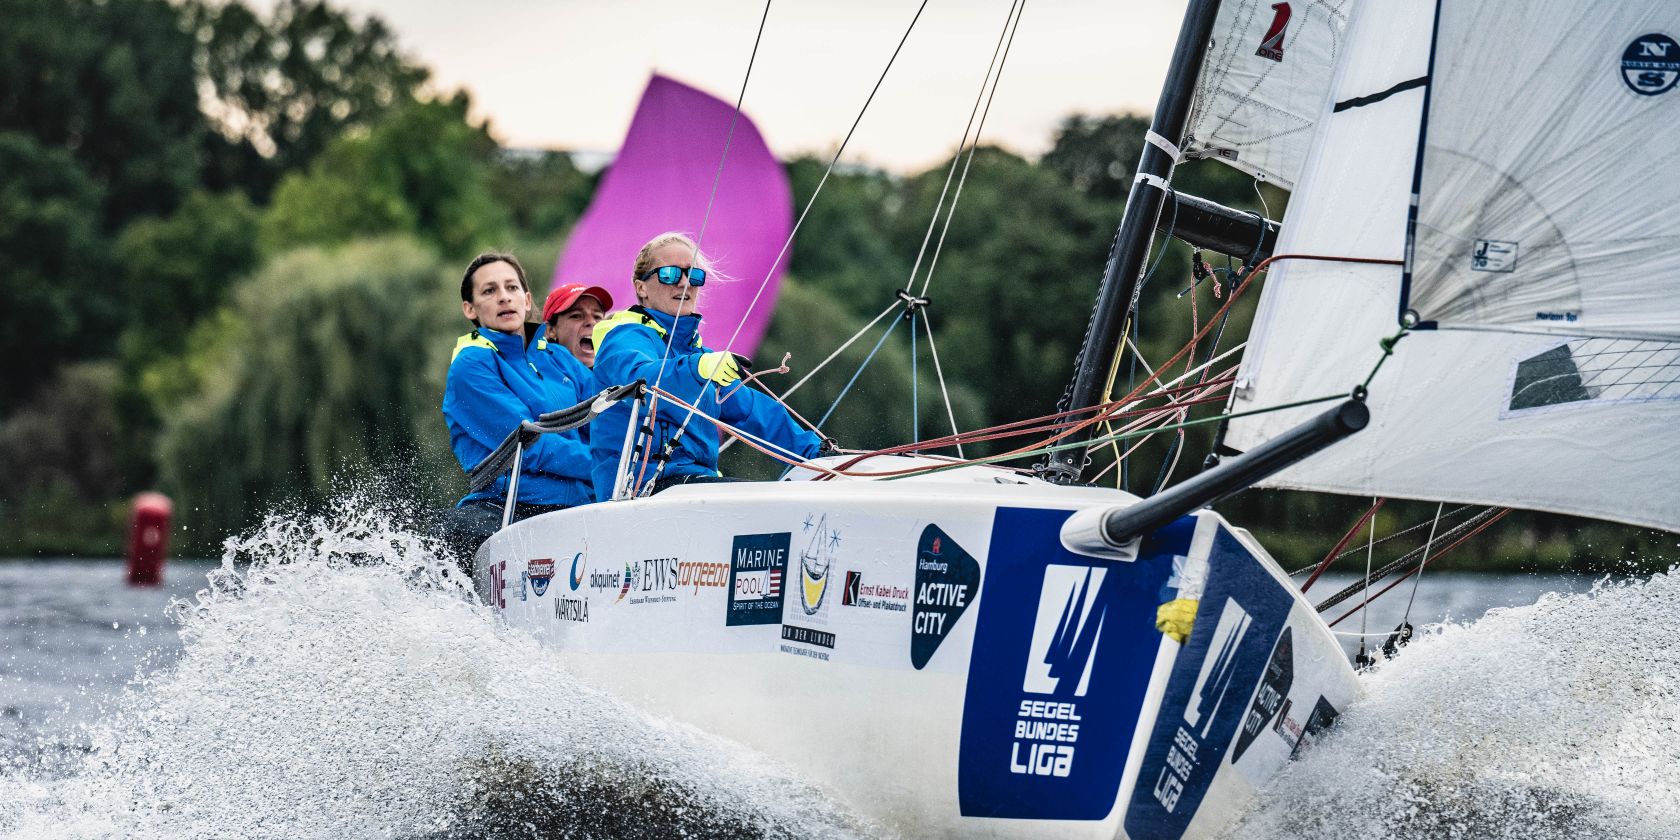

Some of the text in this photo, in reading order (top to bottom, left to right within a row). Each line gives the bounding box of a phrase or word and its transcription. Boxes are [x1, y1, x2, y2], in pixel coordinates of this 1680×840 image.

[1638, 41, 1672, 57] N
[1637, 72, 1665, 87] S
[642, 558, 678, 592] EWS
[919, 558, 948, 574] Hamburg
[590, 568, 620, 593] akquinet
[860, 583, 874, 595] Ernst
[893, 586, 909, 599] Druck
[917, 582, 967, 607] ACTIVE
[915, 611, 946, 635] CITY
[1018, 700, 1081, 720] SEGEL
[1015, 720, 1079, 742] BUNDES
